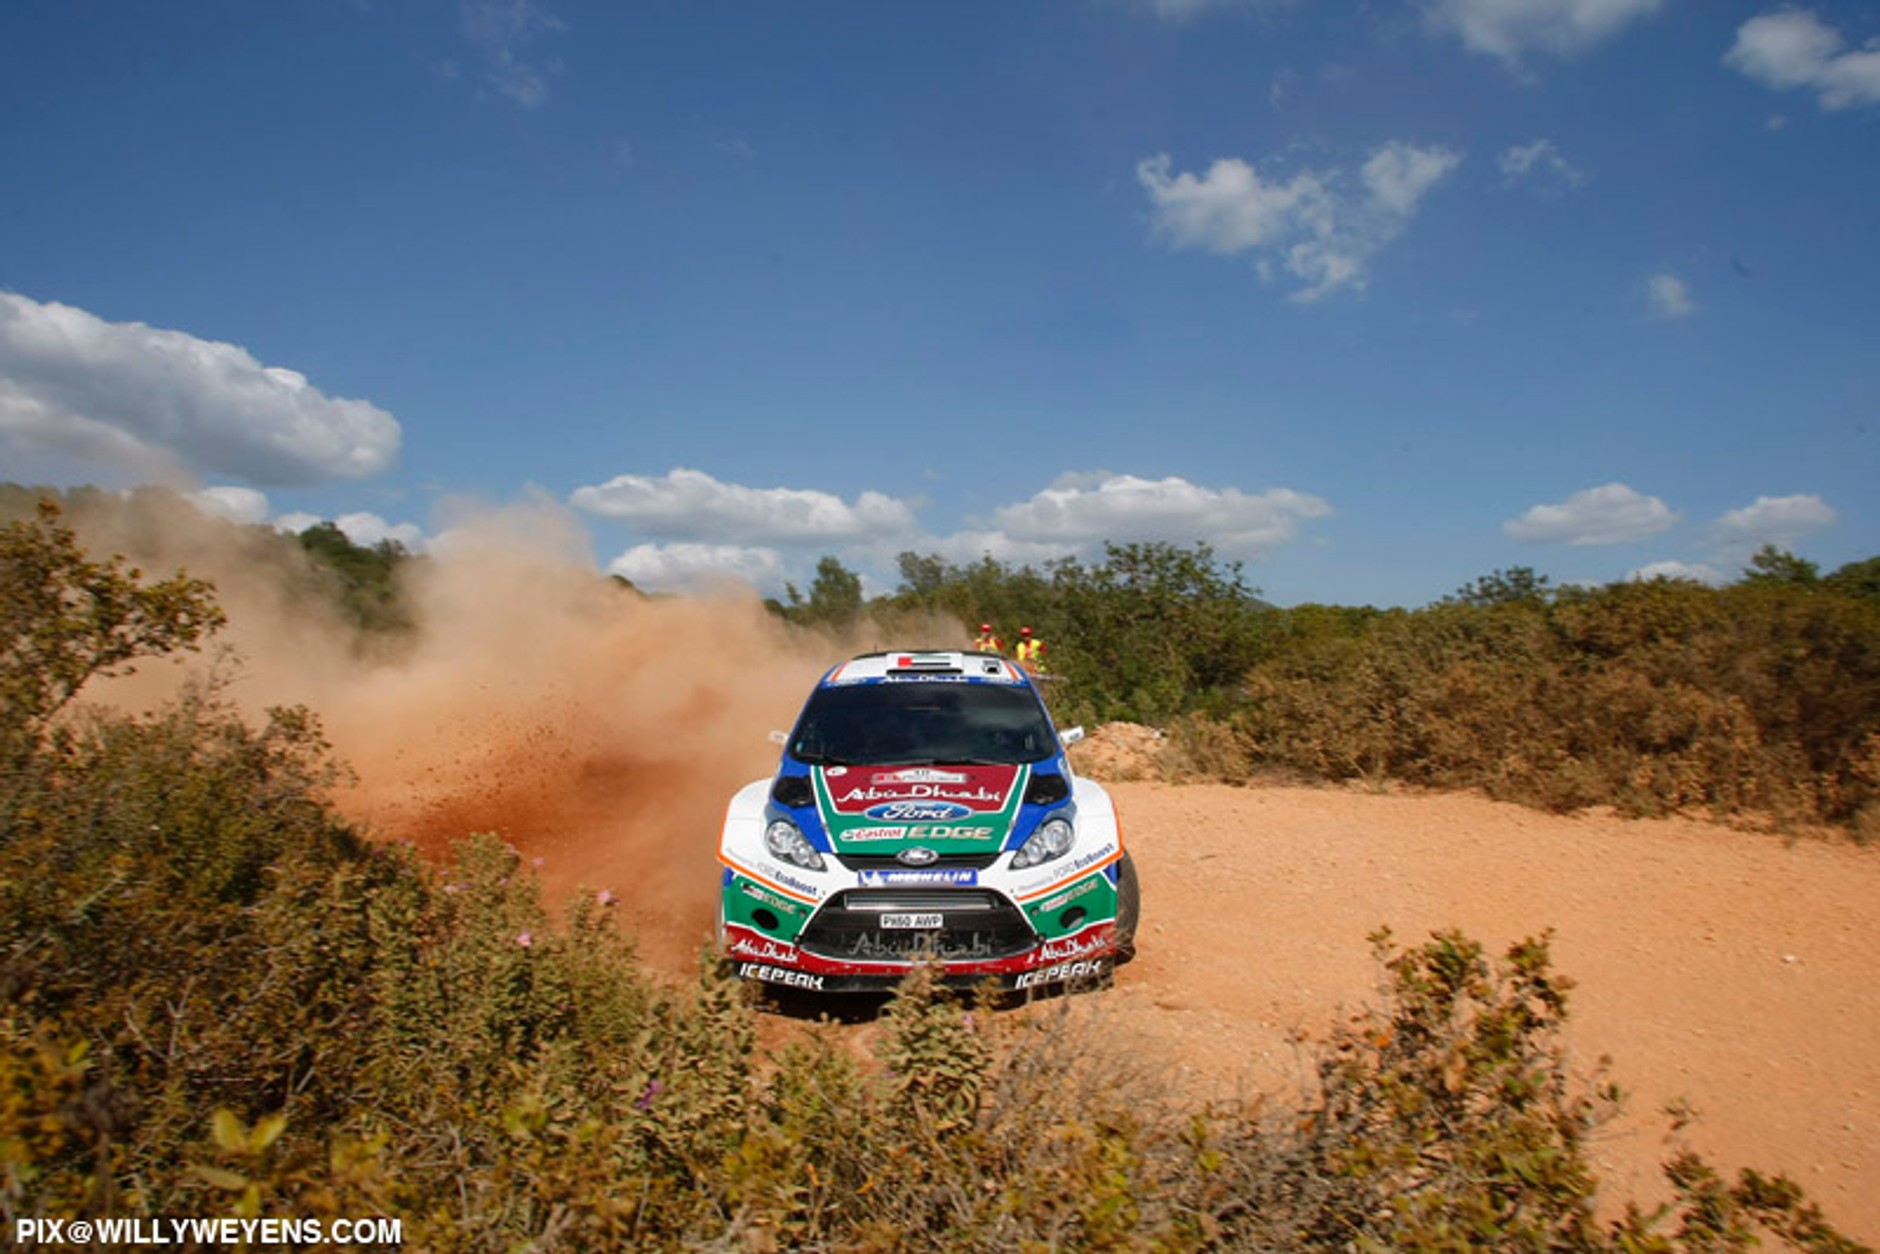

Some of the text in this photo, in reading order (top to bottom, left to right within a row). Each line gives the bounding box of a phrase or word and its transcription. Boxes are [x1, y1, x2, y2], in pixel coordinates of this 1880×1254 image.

[883, 804, 953, 819] Ford
[855, 826, 993, 840] Castrol EDGE
[887, 871, 972, 882] MICHELIN
[740, 962, 824, 990] ICEPEAK
[1015, 959, 1102, 990] ICEPEAK
